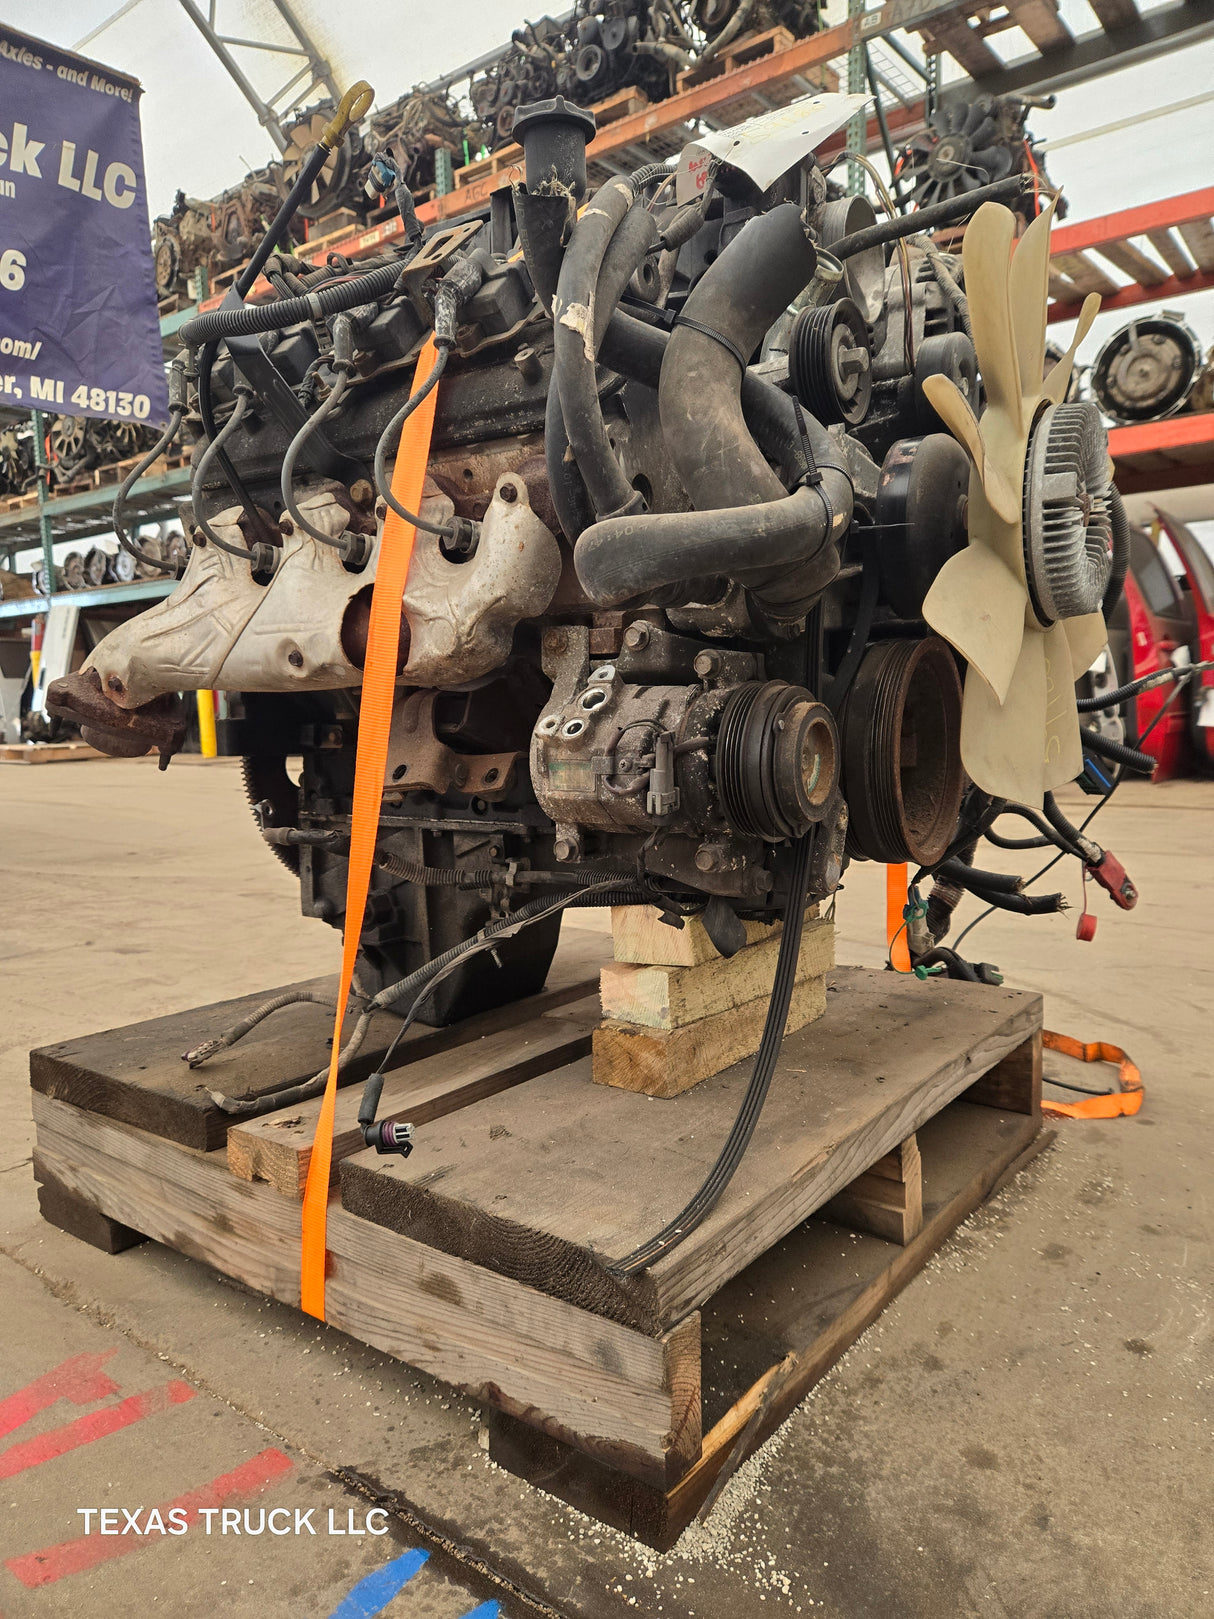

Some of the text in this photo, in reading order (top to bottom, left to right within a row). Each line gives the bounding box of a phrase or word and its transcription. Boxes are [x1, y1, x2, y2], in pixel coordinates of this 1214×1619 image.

[56, 65, 88, 88] and
[90, 75, 134, 104] More!
[58, 140, 137, 209] LLC
[0, 249, 27, 291] 6
[30, 375, 65, 404] MI
[71, 385, 151, 419] 48130
